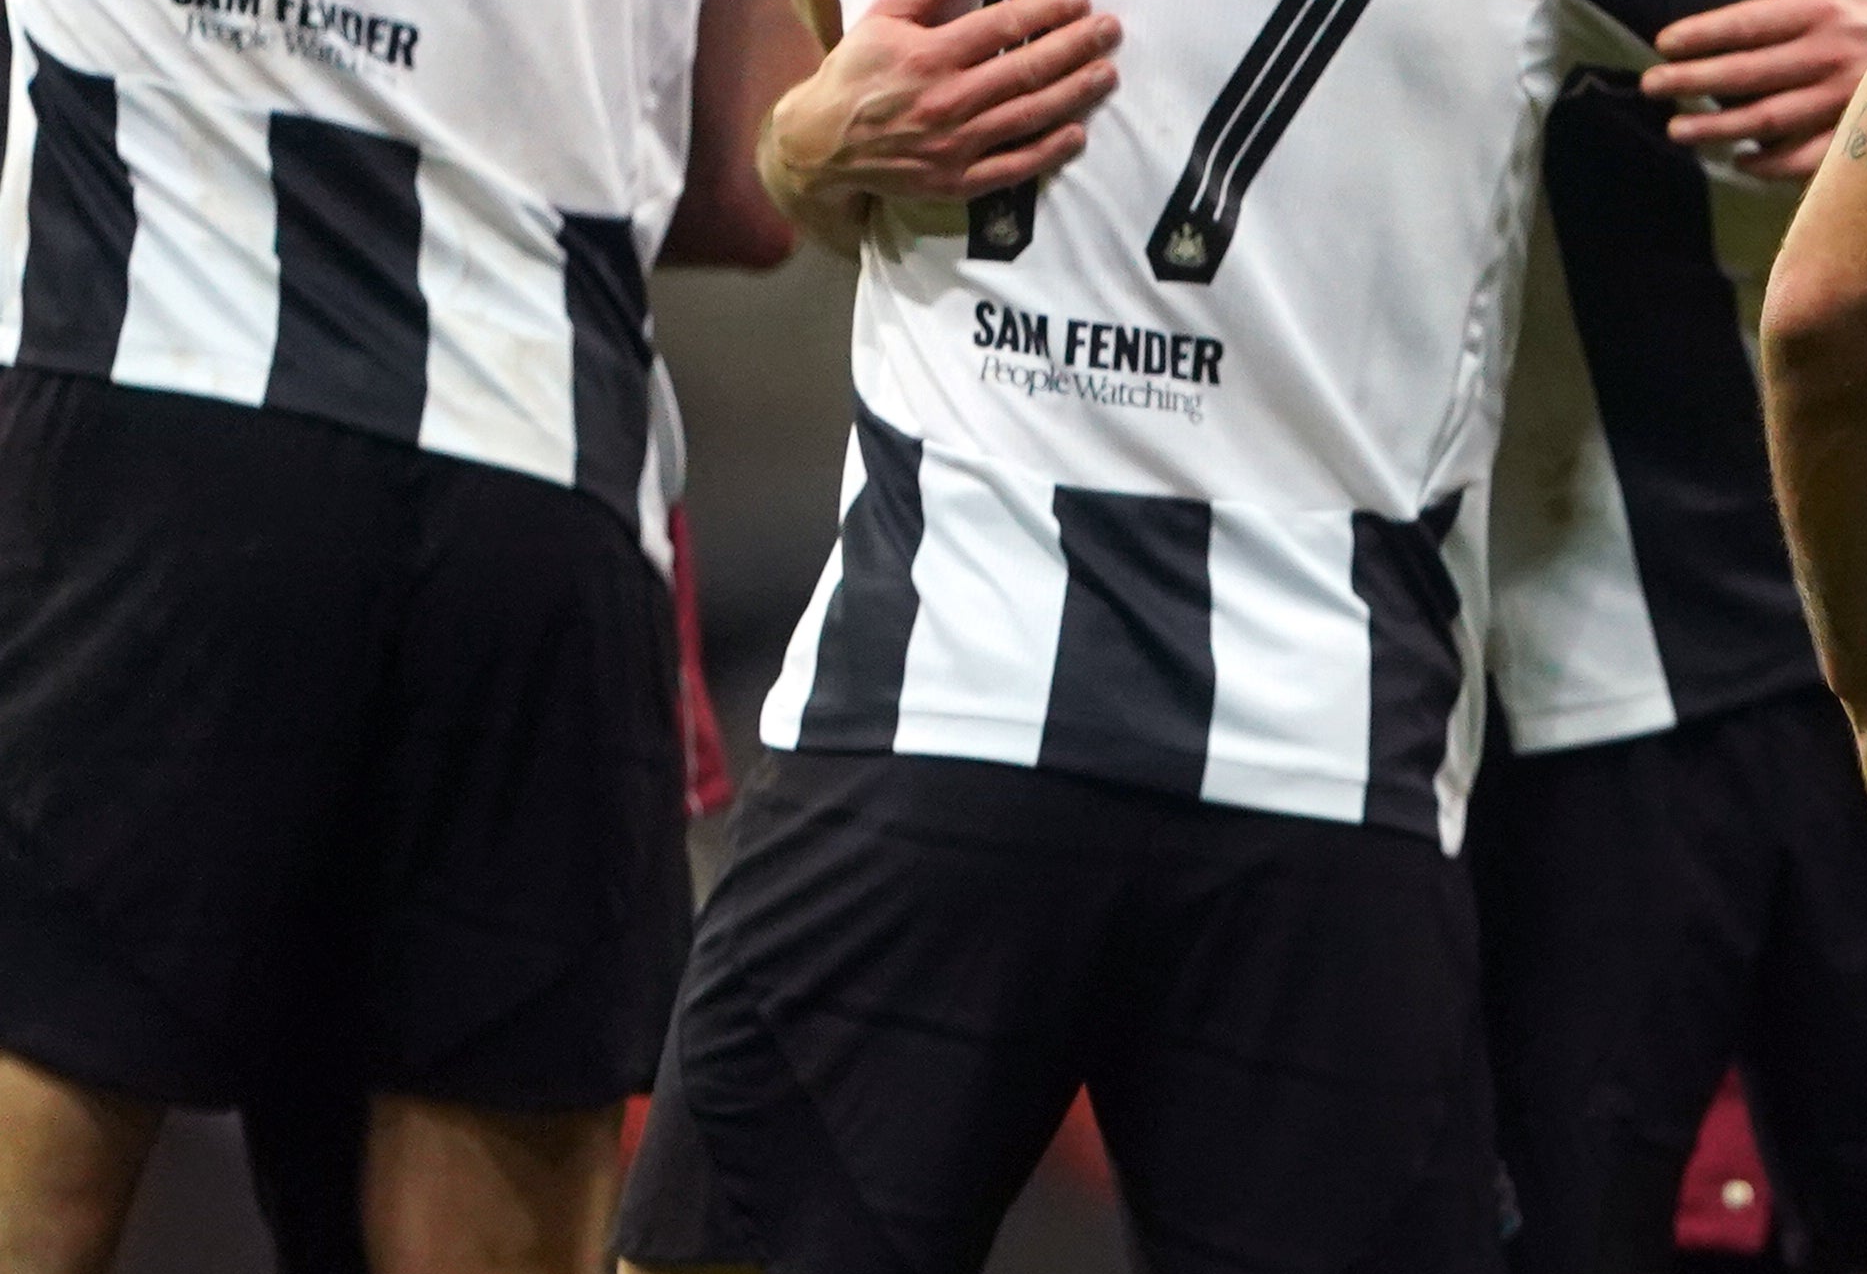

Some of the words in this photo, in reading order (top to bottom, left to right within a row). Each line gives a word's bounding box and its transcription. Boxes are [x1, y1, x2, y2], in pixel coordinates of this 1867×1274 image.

[973, 300, 1050, 359] SAM
[1064, 318, 1224, 385] FENDER
[1072, 373, 1204, 424] Watching
